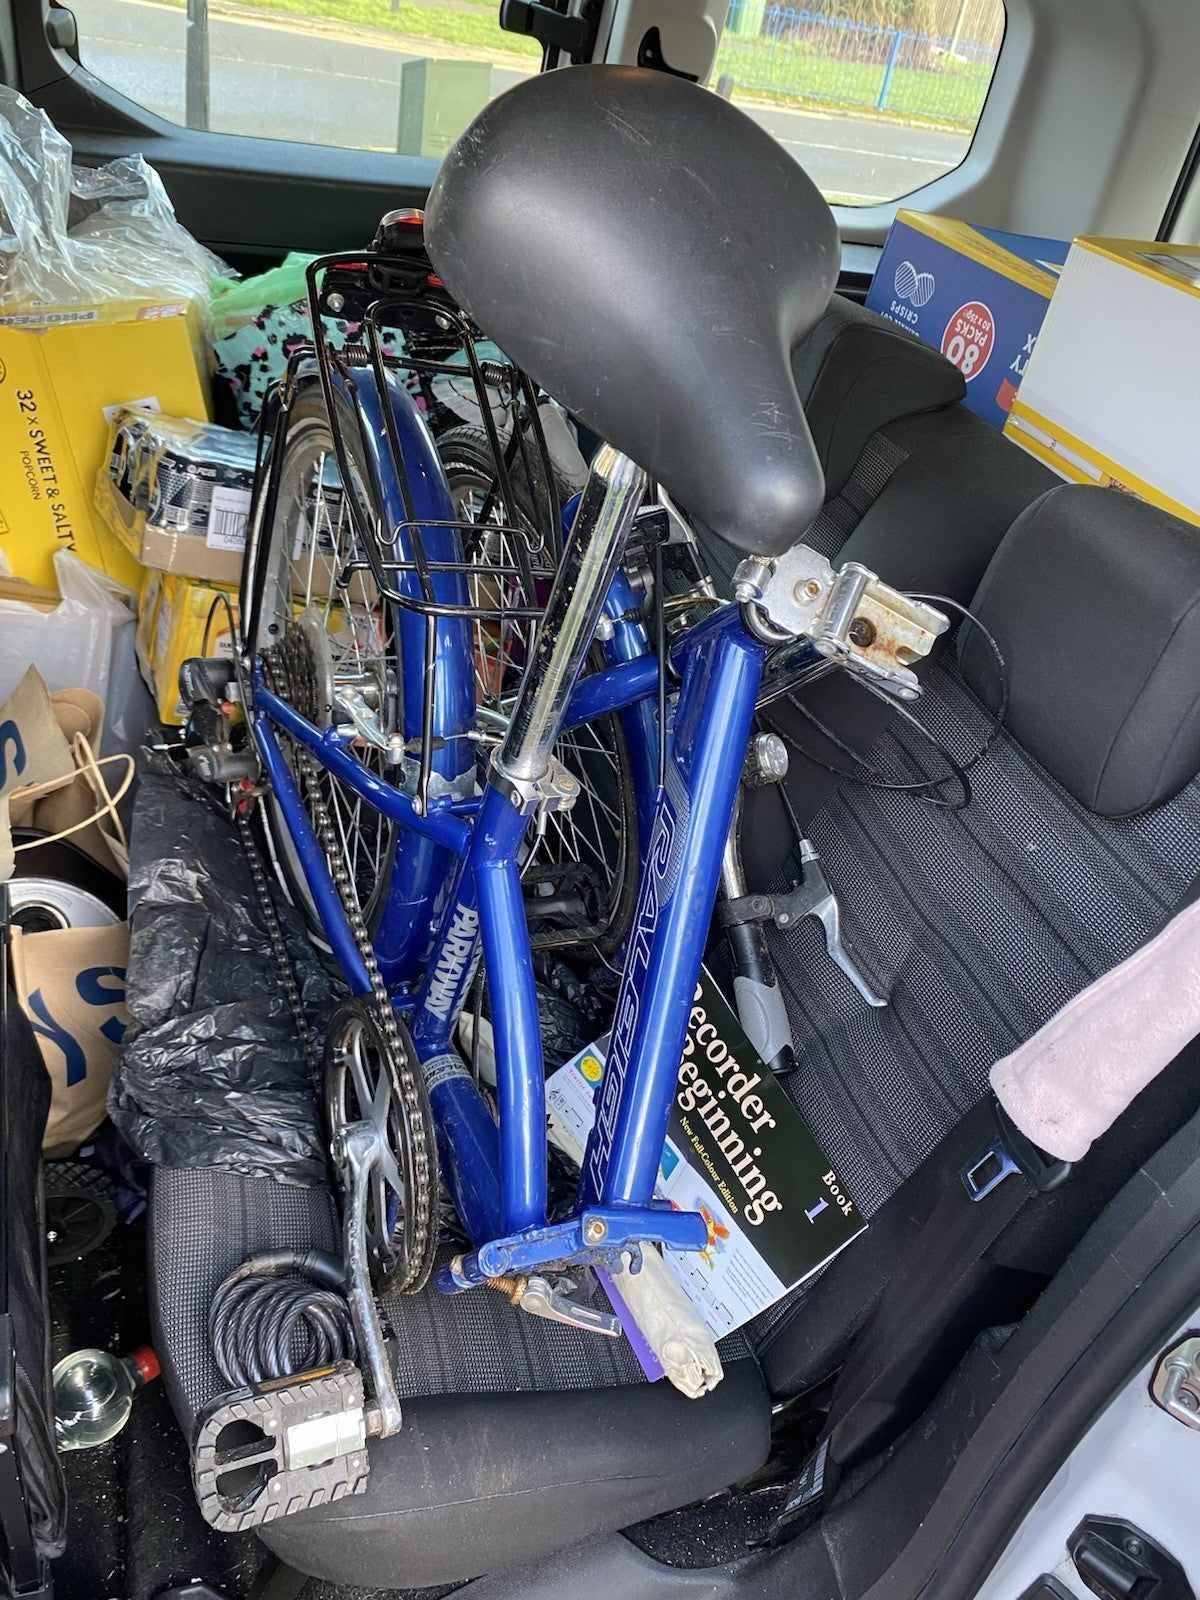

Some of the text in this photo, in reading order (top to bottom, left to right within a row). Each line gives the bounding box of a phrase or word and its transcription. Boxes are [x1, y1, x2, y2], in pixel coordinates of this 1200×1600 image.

[890, 300, 919, 325] CRISPS
[954, 318, 989, 347] PACKS
[946, 335, 980, 375] 80
[16, 389, 37, 413] 32
[29, 429, 58, 486] SWEET
[45, 487, 60, 499] &
[20, 450, 42, 500] POPCORN
[424, 902, 479, 1021] PARKWAY
[588, 802, 677, 1201] RALEIGH
[679, 1115, 739, 1214] New Full-Colour Edition
[803, 1196, 830, 1224] 1
[821, 1169, 853, 1217] Book
